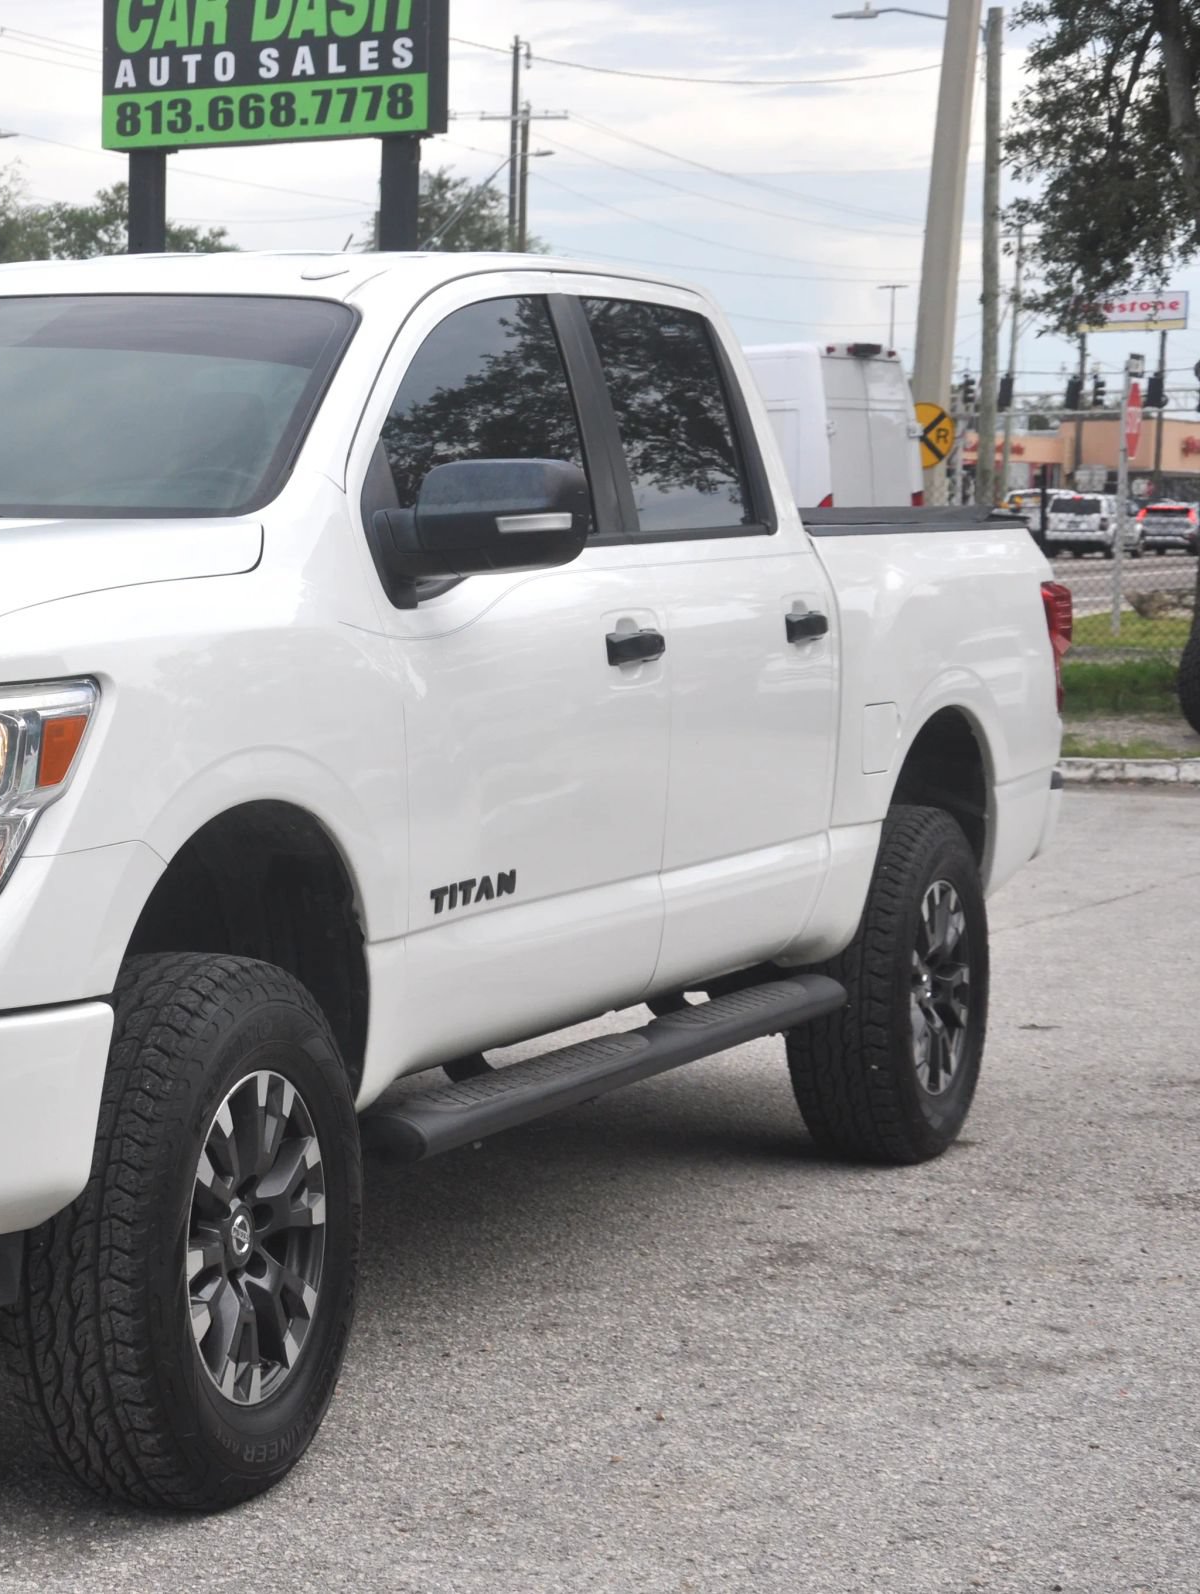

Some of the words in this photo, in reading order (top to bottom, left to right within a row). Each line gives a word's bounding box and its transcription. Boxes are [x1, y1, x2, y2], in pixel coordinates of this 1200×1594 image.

[115, 0, 228, 54] CAR
[115, 51, 236, 89] AUTO
[258, 37, 415, 79] SALES
[115, 82, 414, 137] 813.668.7778
[935, 428, 950, 444] R
[430, 868, 517, 915] TITAN
